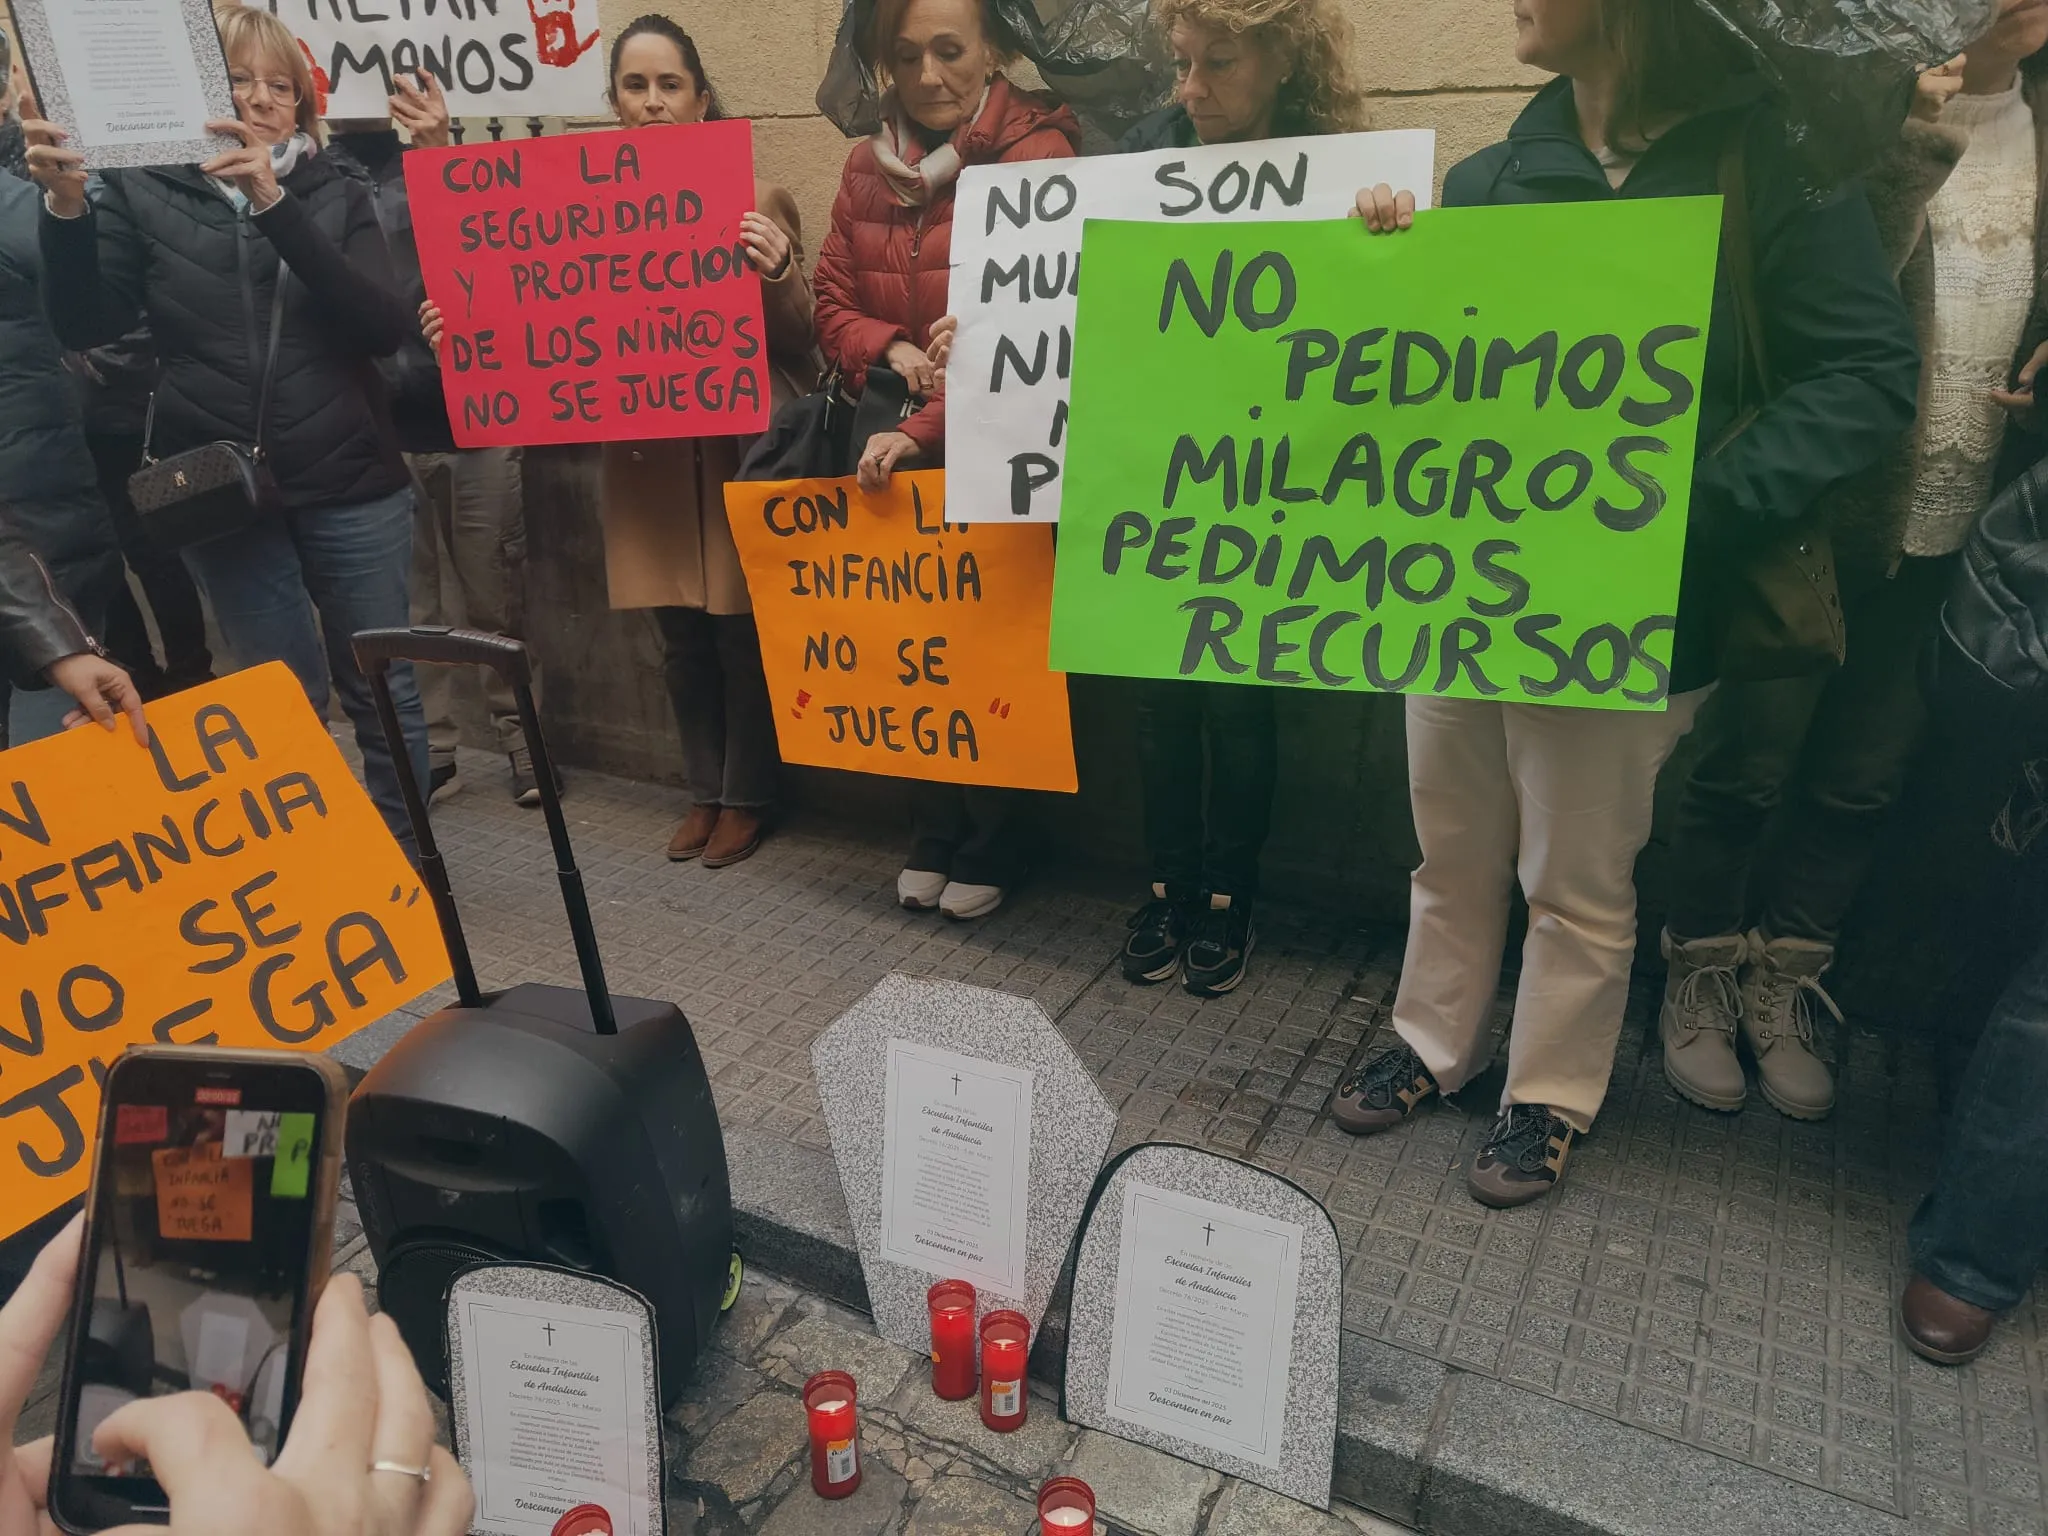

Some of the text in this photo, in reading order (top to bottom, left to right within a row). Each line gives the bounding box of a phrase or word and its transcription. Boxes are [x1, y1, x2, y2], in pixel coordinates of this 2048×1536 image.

[329, 33, 534, 96] MANOS
[442, 143, 641, 192] CON LA
[986, 152, 1308, 236] NO SON
[453, 268, 474, 318] Y
[1158, 248, 1298, 338] NO
[451, 330, 503, 373] DE
[525, 316, 602, 370] LOS
[462, 366, 760, 431] NO SE JUEGA
[763, 479, 969, 537] CON L
[804, 631, 950, 686] NO SE
[1177, 595, 1677, 704] RECURSOS
[145, 703, 260, 792] LA
[178, 869, 303, 974] SE
[921, 1105, 954, 1121] Escuelas
[955, 1115, 993, 1133] Infantiles
[931, 1125, 941, 1134] de
[914, 1234, 956, 1254] Descansen
[967, 1252, 984, 1262] paz
[1164, 1255, 1252, 1288] Escuelas Infantiles
[1175, 1276, 1187, 1286] de
[509, 1360, 600, 1383] Escuelas Infantiles
[524, 1380, 536, 1389] de
[1148, 1391, 1233, 1426] Descansen en paz
[514, 1498, 566, 1515] Descansen
